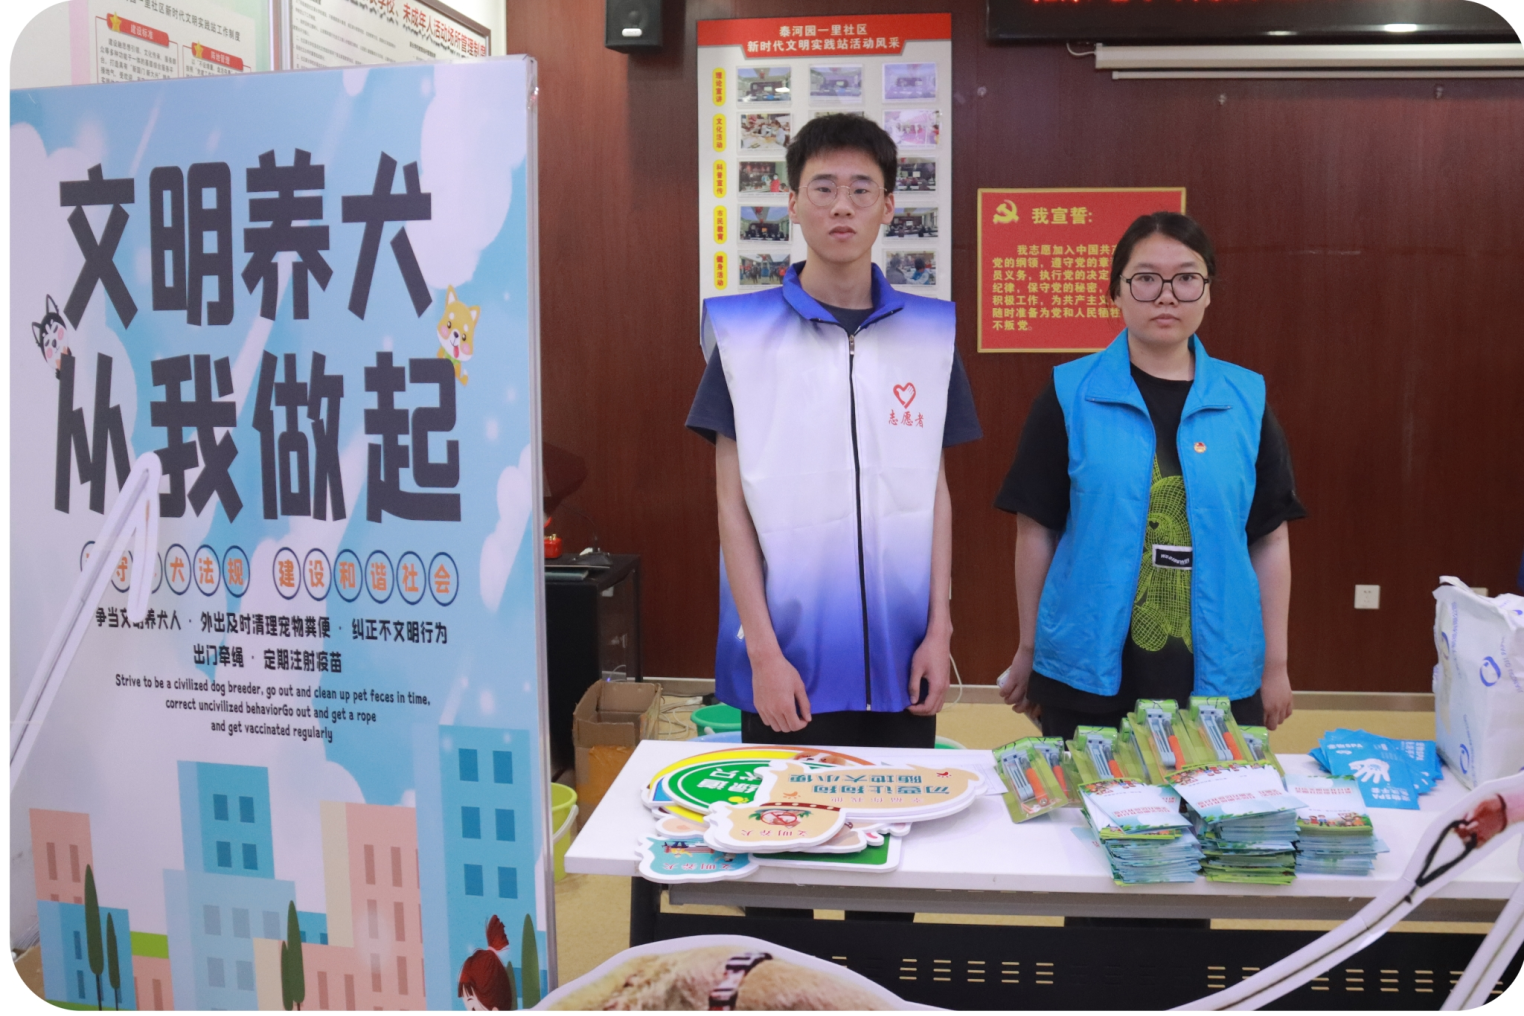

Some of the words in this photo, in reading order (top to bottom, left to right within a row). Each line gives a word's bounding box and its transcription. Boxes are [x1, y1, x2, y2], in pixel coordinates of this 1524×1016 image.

[130, 24, 154, 40] 建设标准
[779, 23, 868, 38] 泰河园一里社区
[210, 51, 231, 65] 阵地管理
[747, 37, 901, 53] 新时代文明实践站活动风采
[716, 164, 724, 195] 科普宣传
[60, 148, 433, 330] 文明养犬
[716, 255, 724, 287] 健身活动
[992, 307, 1121, 319] 随时准备为党和人民牺牲
[888, 408, 925, 430] 志愿者
[55, 350, 461, 523] 从我做起
[83, 549, 246, 590] 守犬法规
[277, 557, 453, 597] 建设和谐社会
[96, 606, 181, 630] 争当文养犬人
[200, 611, 330, 639] 外出及时清理宠物粪便
[352, 618, 448, 644] 纠正不文明行为
[193, 643, 244, 668] 出门牵绳
[264, 648, 342, 673] 定期注射疫苗
[115, 673, 141, 687] Strive
[143, 675, 152, 688] to
[154, 676, 164, 689] be
[166, 680, 172, 689] a
[174, 678, 208, 691] civilized
[211, 680, 225, 696] dog
[266, 686, 276, 700] go
[278, 684, 294, 697] out
[296, 685, 311, 698] and
[314, 686, 337, 700] clean
[339, 690, 350, 704] up
[353, 689, 368, 704] pet
[370, 689, 394, 703] feces
[396, 691, 405, 703] in
[165, 698, 196, 710] correct
[198, 699, 243, 713] uncivilized
[296, 706, 311, 718] out
[314, 707, 329, 719] and
[332, 708, 346, 723] get
[348, 711, 354, 721] a
[357, 713, 376, 725] rope
[211, 720, 225, 732] and
[228, 721, 242, 736] get
[244, 723, 290, 737] vaccinated
[293, 725, 333, 743] regularly
[812, 785, 951, 795] 勿要让狗狗
